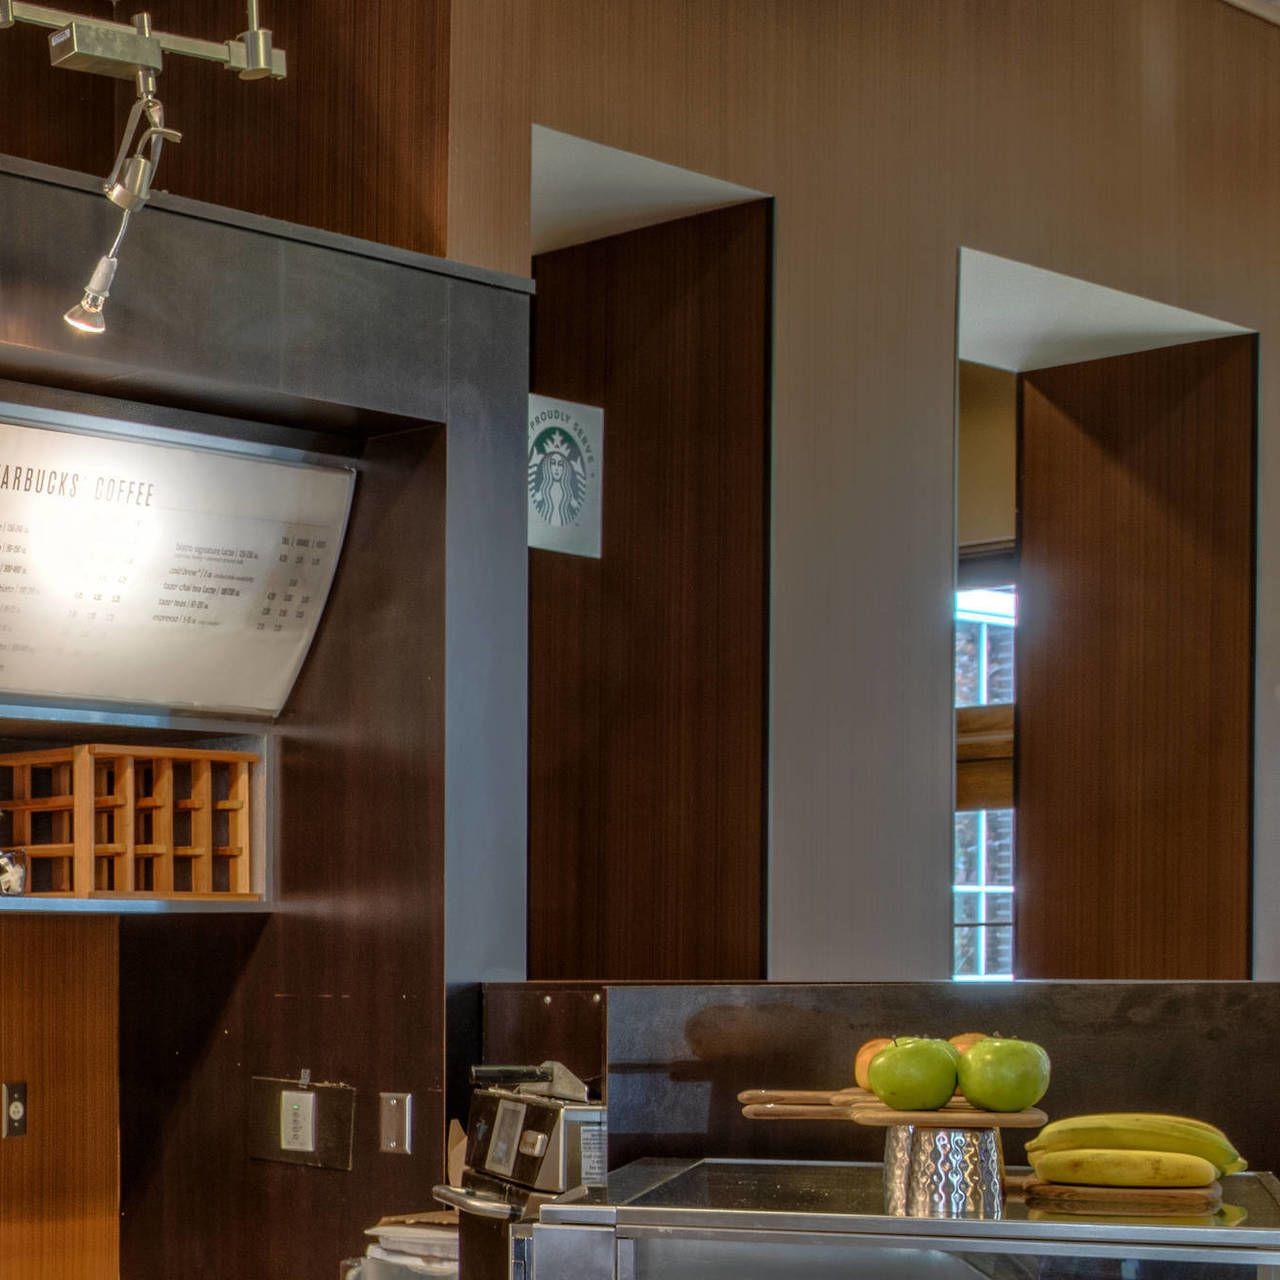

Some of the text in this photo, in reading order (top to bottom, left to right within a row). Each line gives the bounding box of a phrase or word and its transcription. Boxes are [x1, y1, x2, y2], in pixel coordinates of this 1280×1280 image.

[530, 409, 594, 464] PROUDLY SERVE
[95, 476, 155, 507] COFFEE
